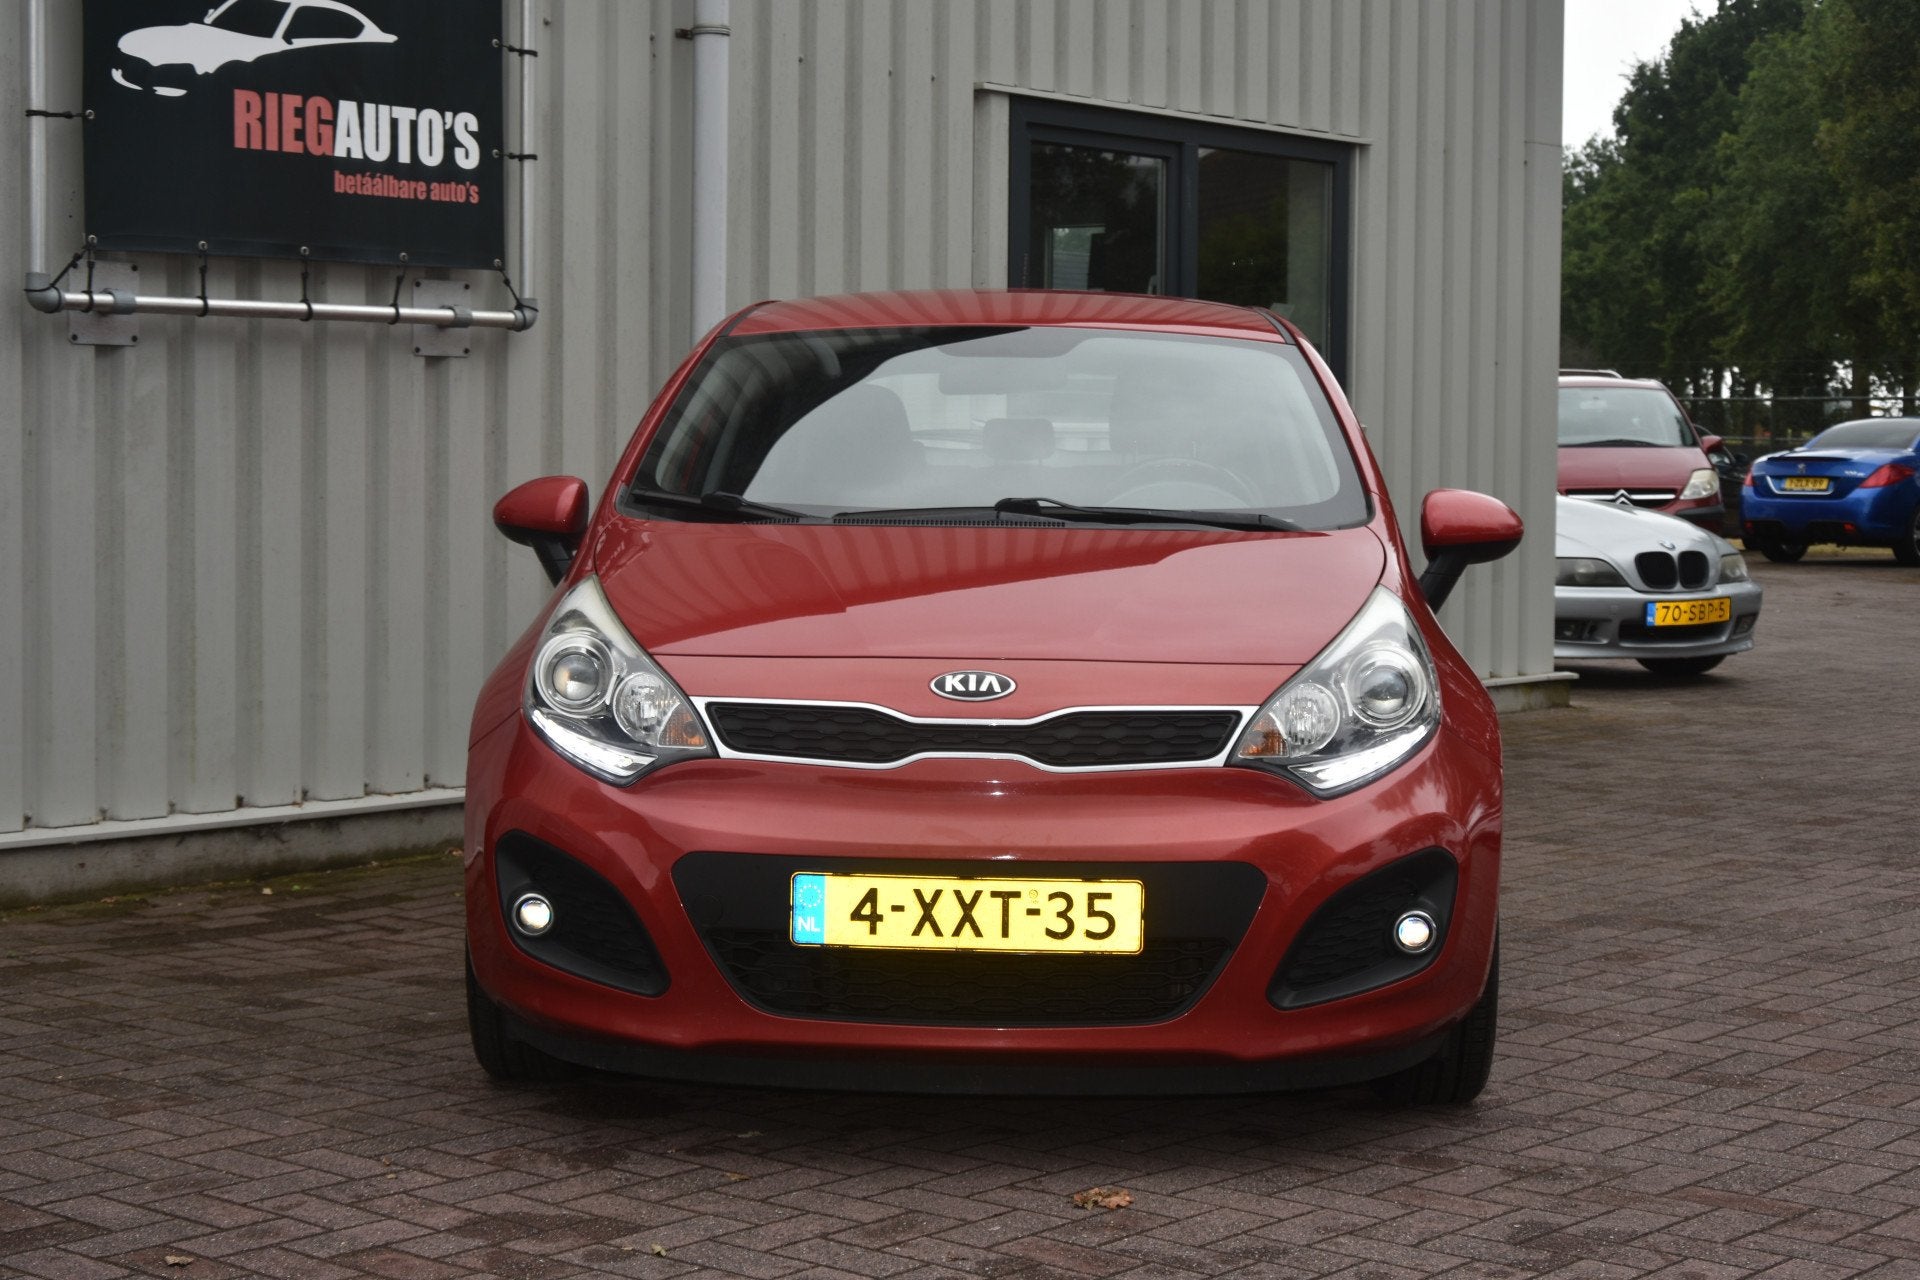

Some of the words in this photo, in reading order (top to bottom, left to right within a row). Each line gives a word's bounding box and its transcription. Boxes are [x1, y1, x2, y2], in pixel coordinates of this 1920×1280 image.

[334, 170, 427, 200] betáálbare
[430, 181, 479, 204] auto's
[945, 674, 1001, 692] KIA
[798, 916, 820, 932] NL
[850, 887, 1116, 941] 4-XXT-35
